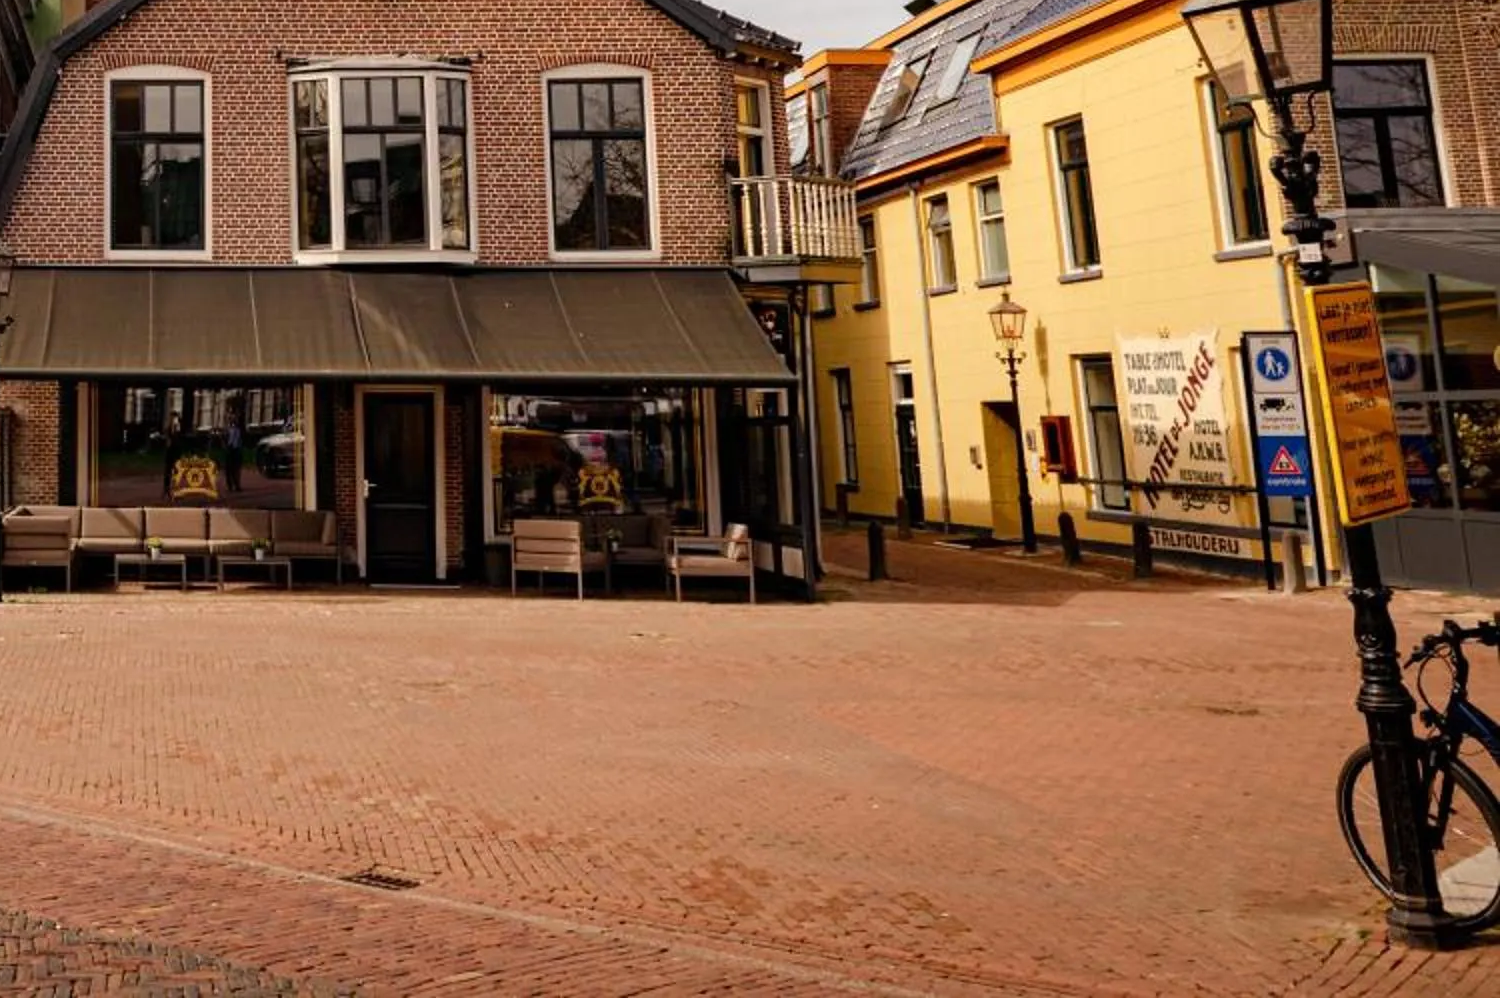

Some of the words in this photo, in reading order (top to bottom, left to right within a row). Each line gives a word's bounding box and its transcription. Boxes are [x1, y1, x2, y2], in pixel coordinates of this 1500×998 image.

[1124, 353, 1151, 370] TABLE
[1127, 377, 1147, 394] PLAT
[1155, 377, 1179, 395] JOUR
[1143, 433, 1179, 510] HOTEL
[1177, 340, 1215, 427] JONGE
[1193, 419, 1221, 435] HOTEL
